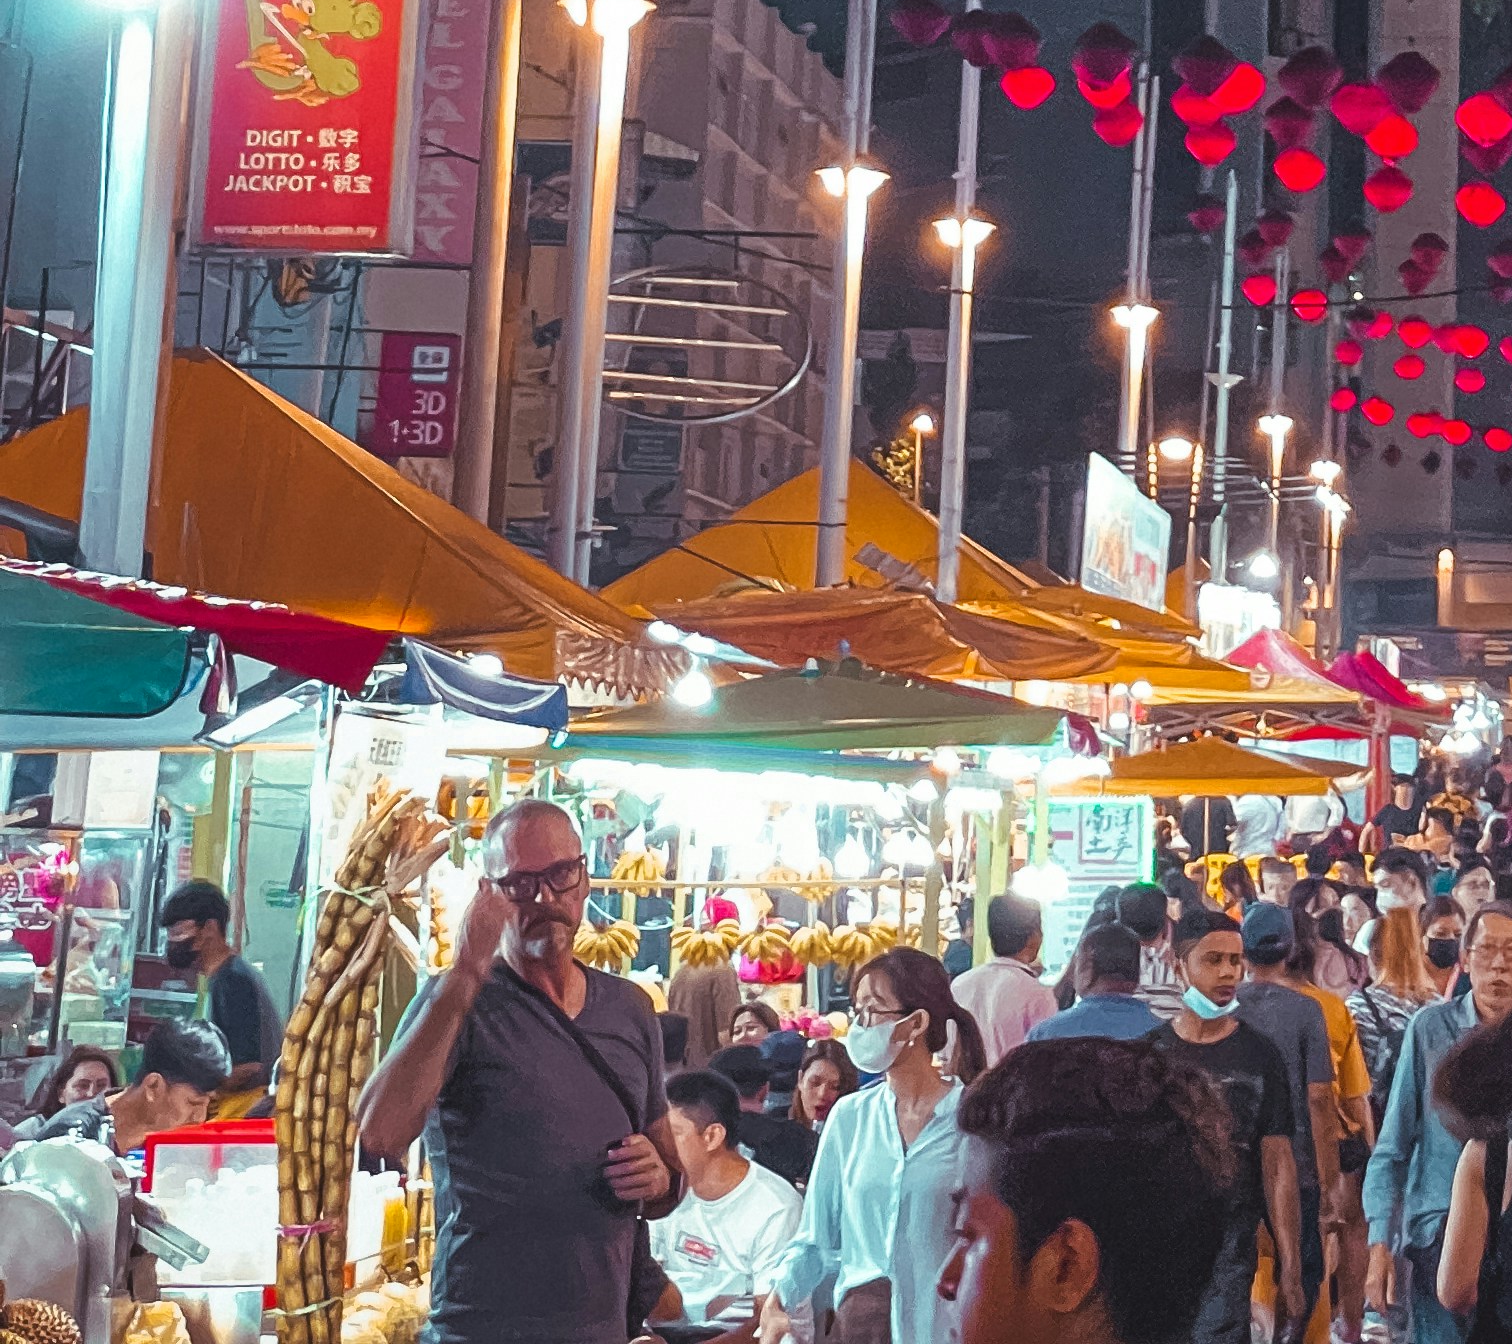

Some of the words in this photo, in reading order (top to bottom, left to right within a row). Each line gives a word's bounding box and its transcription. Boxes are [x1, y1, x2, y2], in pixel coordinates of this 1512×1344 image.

[246, 129, 302, 147] DIGIT
[239, 153, 305, 170] LOTTO
[224, 175, 317, 192] JACKPOT
[412, 389, 447, 415] 3D
